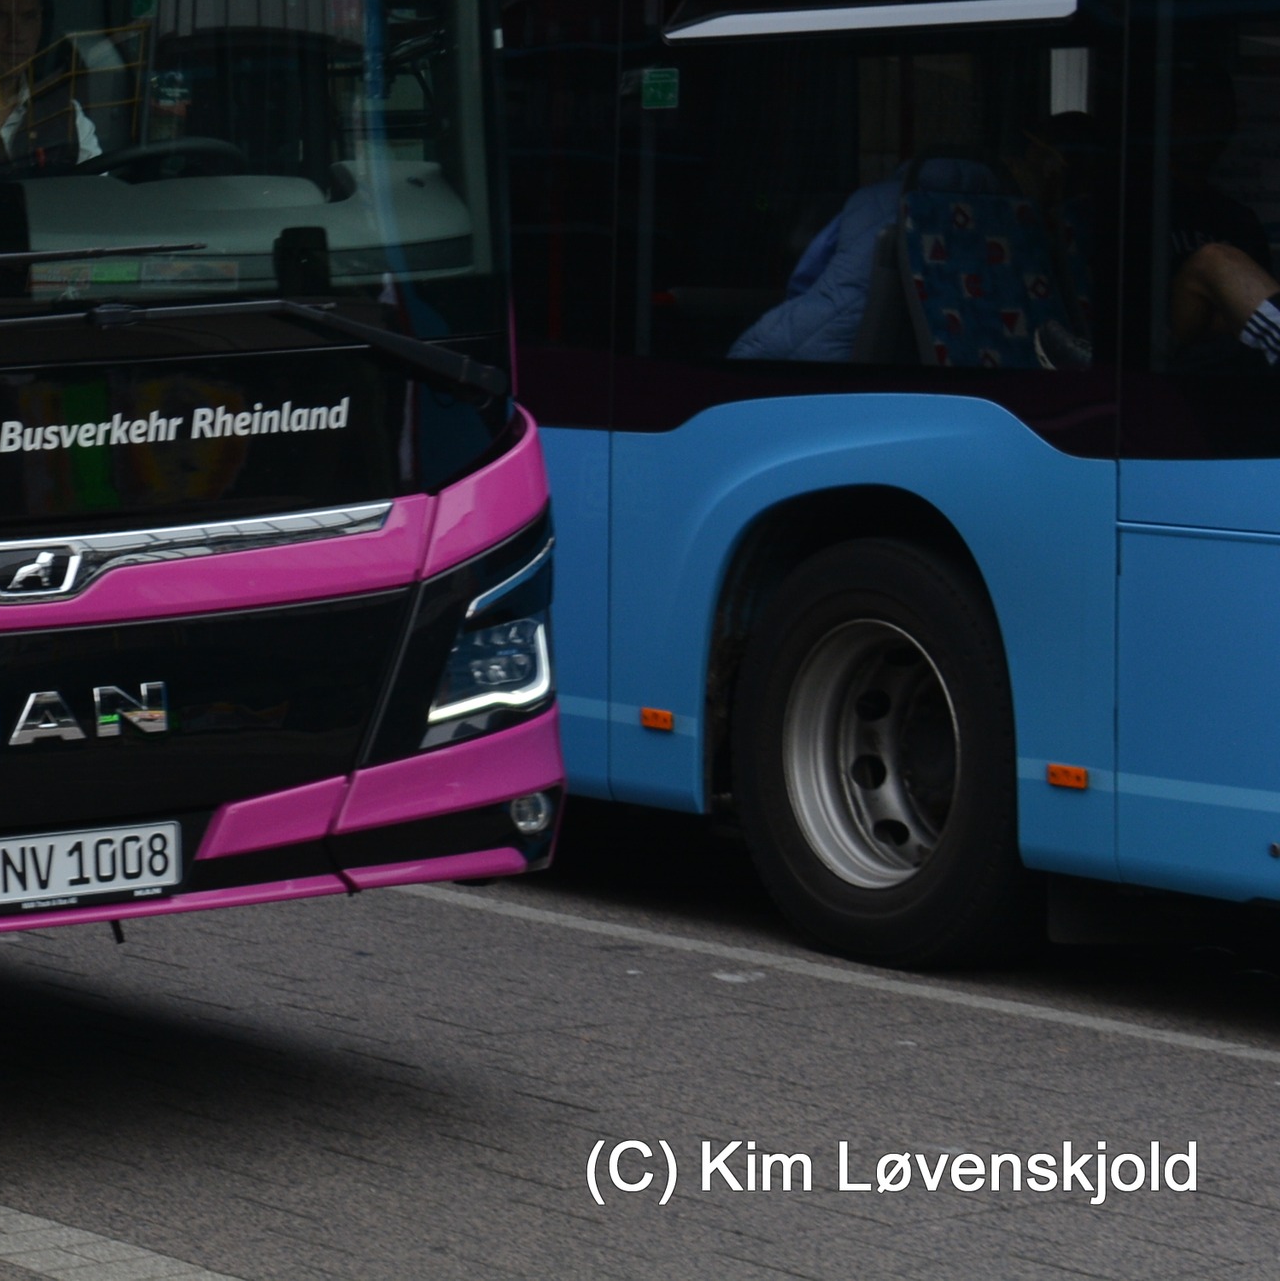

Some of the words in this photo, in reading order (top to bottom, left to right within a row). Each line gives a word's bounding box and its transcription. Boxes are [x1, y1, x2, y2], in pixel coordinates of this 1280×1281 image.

[0, 410, 183, 453] Busverkehr
[191, 397, 349, 439] Rheinland
[1, 844, 56, 894] NV
[66, 833, 170, 887] 1008
